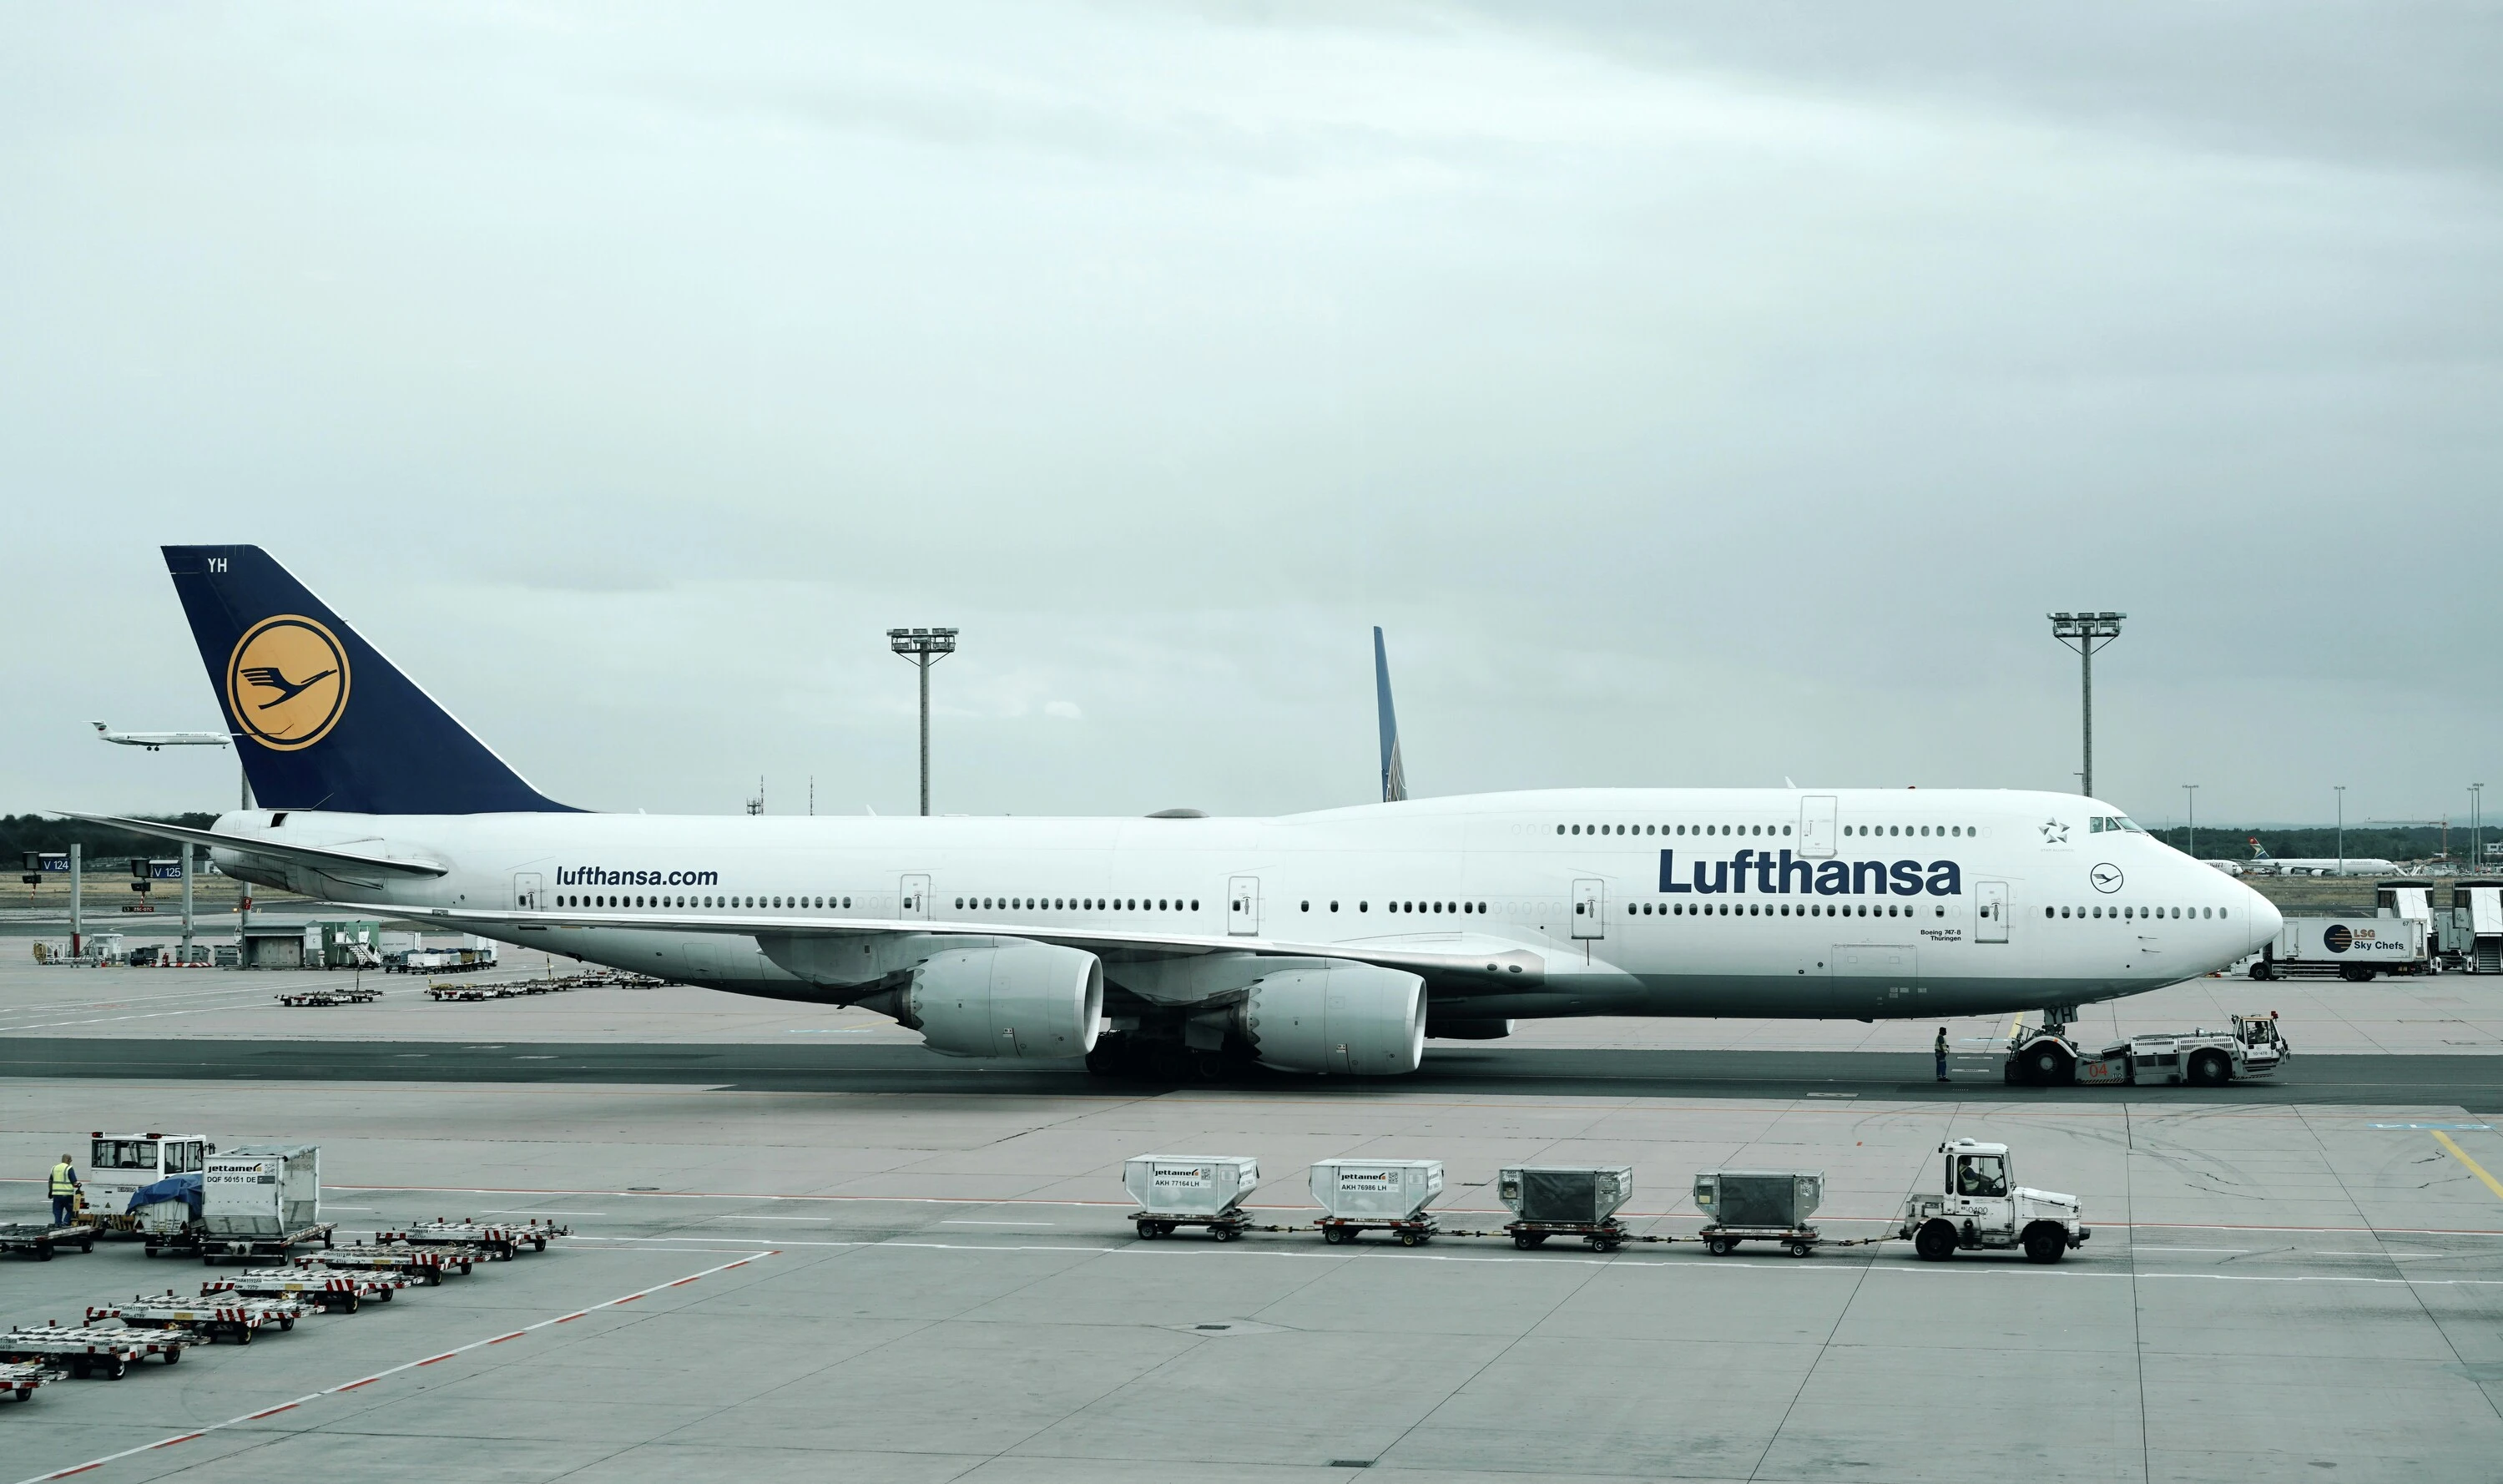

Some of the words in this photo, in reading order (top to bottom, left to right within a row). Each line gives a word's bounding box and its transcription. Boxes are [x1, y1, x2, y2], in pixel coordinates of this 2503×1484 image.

[208, 558, 227, 573] YH
[44, 861, 52, 870] V
[53, 861, 69, 870] 124
[154, 867, 163, 876] V
[165, 867, 181, 877] 125
[557, 866, 719, 886] lufthansa.com
[1659, 849, 1962, 896] Lufthansa
[2354, 929, 2376, 938] LSG
[2354, 941, 2372, 951] Sky
[2374, 941, 2405, 950] Chefs
[2049, 1006, 2074, 1024] YH
[2089, 1062, 2108, 1078] 04
[208, 1163, 262, 1174] jettainer
[1341, 1172, 1386, 1180] jettainer
